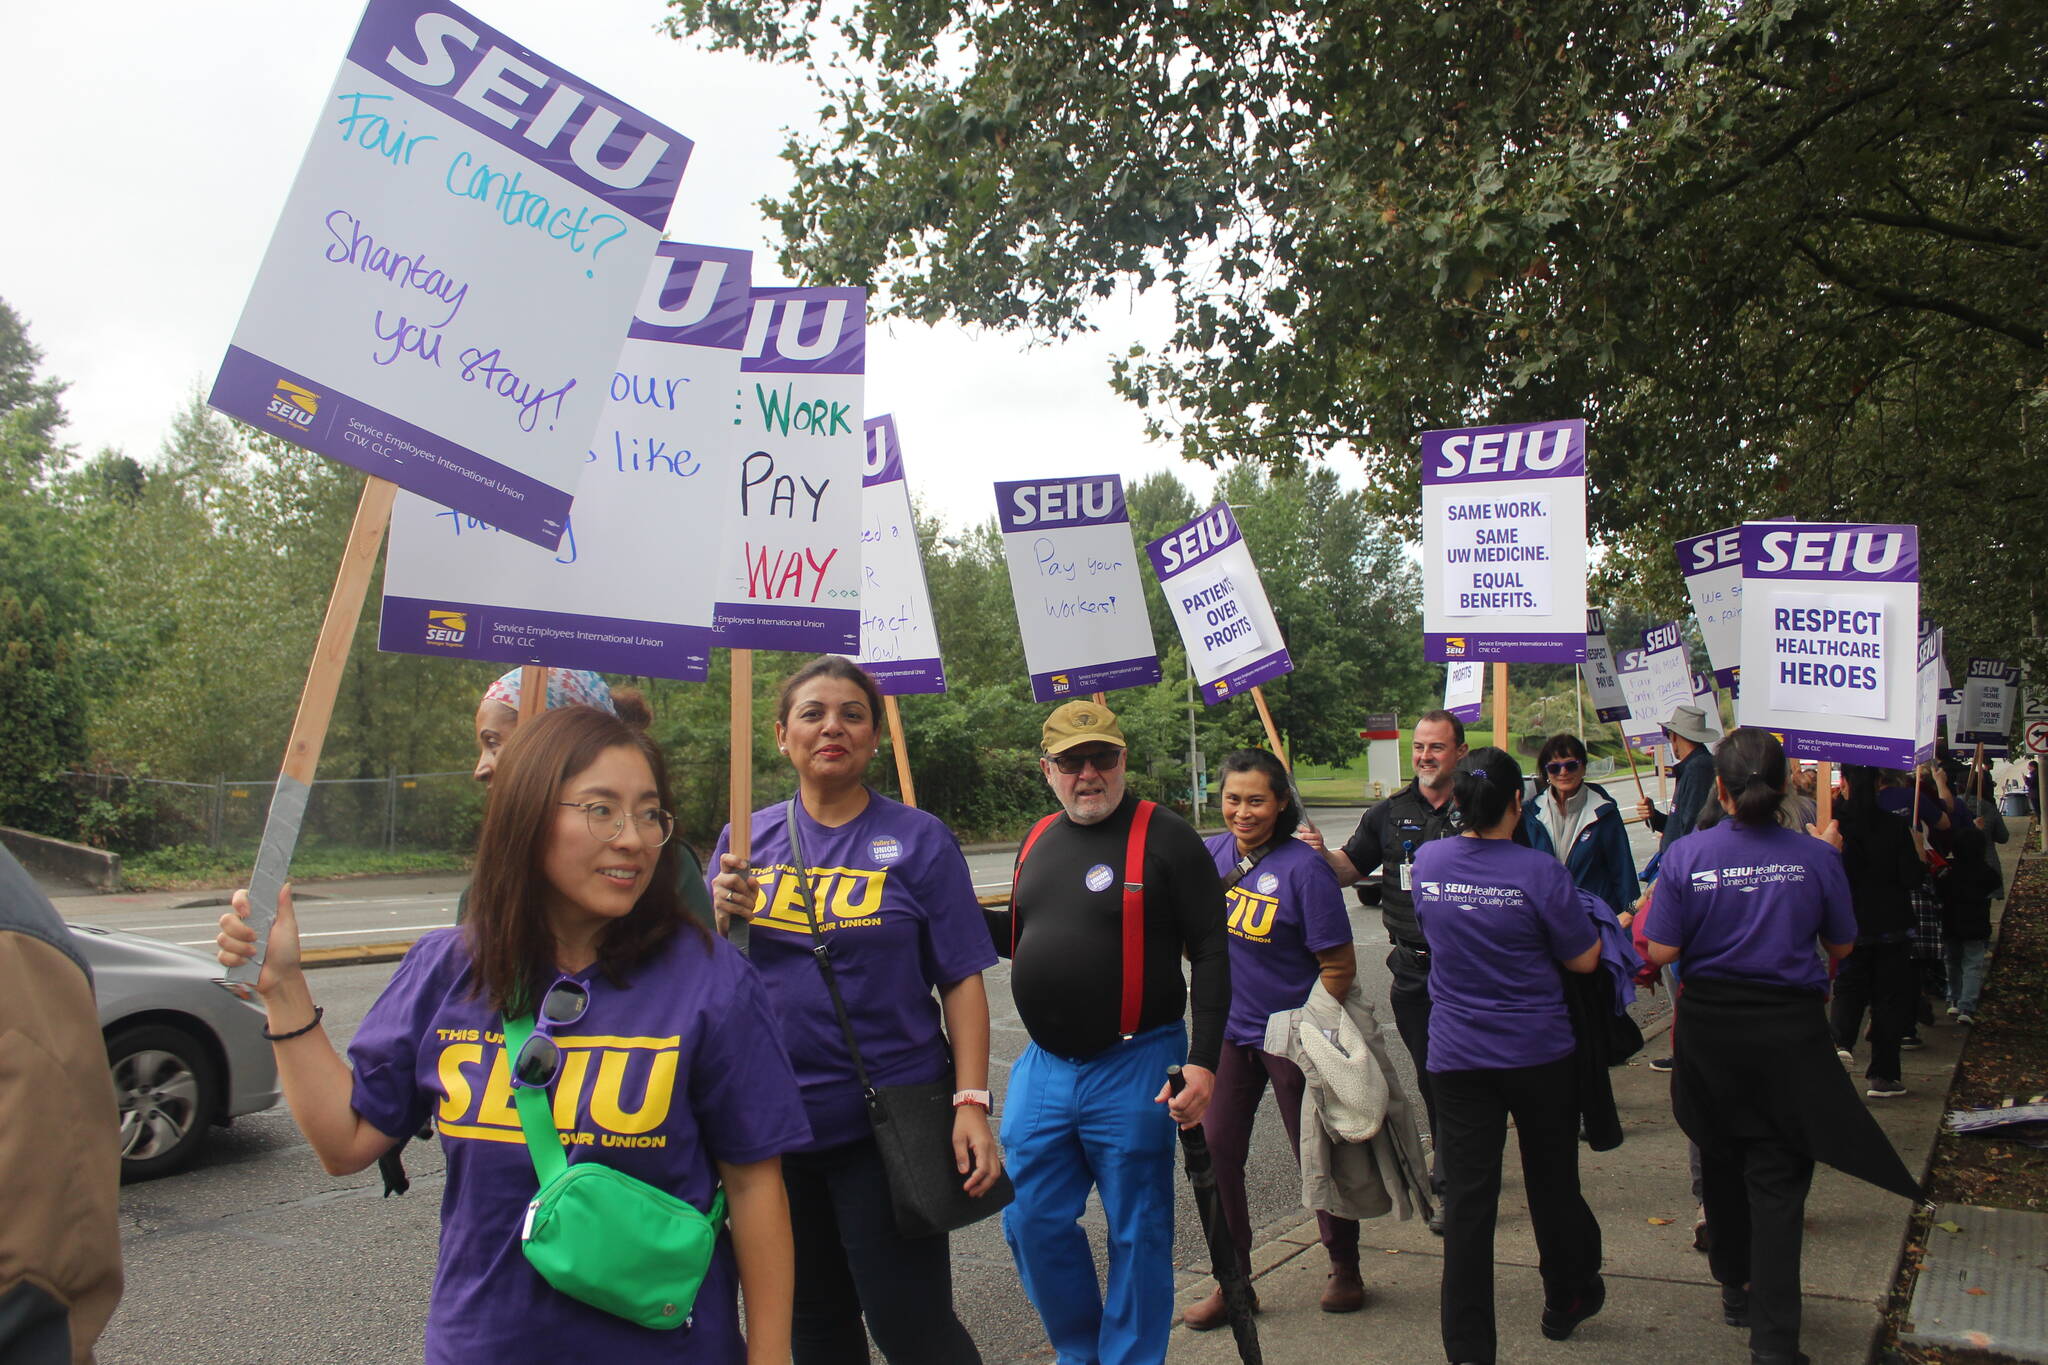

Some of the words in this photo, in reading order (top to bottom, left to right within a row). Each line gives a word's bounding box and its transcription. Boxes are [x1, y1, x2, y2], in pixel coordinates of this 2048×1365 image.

[385, 12, 670, 190] SEIU
[338, 92, 438, 165] Fair
[324, 209, 468, 329] Shantay
[741, 299, 848, 361] IU
[373, 309, 442, 366] you
[459, 347, 577, 433] stay!
[267, 400, 314, 425] SEIU
[349, 418, 383, 438] Service
[384, 432, 436, 463] Employees
[436, 456, 496, 488] International
[496, 482, 526, 502] Union
[371, 442, 393, 458] CLC
[615, 430, 701, 477] like
[1436, 428, 1572, 478] SEIU
[1012, 481, 1114, 525] SEIU
[1448, 503, 1492, 521] SAME
[1495, 500, 1547, 519] WORK.
[1160, 509, 1230, 573] SEIU
[1476, 528, 1518, 545] SAME
[1033, 538, 1076, 581] Pay
[1447, 548, 1471, 563] UW
[1474, 545, 1550, 563] MEDICINE.
[1692, 532, 1741, 570] SE
[1757, 531, 1903, 574] SEIU
[1473, 572, 1524, 589] EQUAL
[1460, 591, 1537, 609] BENEFITS.
[718, 615, 755, 626] Employees
[756, 617, 802, 628] International
[802, 620, 825, 629] Union
[1207, 601, 1239, 627] OVER
[1775, 608, 1881, 635] RESPECT
[425, 628, 465, 643] SEIU
[493, 622, 525, 635] Service
[526, 625, 575, 641] Employees
[576, 630, 634, 645] International
[635, 637, 664, 648] Union
[517, 637, 535, 647] CLC
[1204, 616, 1252, 651] PROFITS
[1647, 625, 1677, 652] SEIU
[1776, 638, 1880, 659] HEALTHCARE
[1780, 662, 1877, 690] HEROES
[1971, 660, 2004, 677] SEIU
[874, 845, 897, 853] UNION
[875, 852, 898, 860] STRONG
[750, 865, 774, 875] THIS
[1722, 877, 1748, 887] United
[1760, 874, 1786, 883] Quality
[1787, 872, 1805, 882] Care
[1225, 890, 1278, 936] IU
[1444, 894, 1467, 903] United
[1468, 895, 1477, 903] for
[1479, 896, 1504, 907] Quality
[1505, 898, 1523, 906] Care
[840, 918, 881, 928] UNION
[1228, 928, 1243, 937] OUR
[1244, 934, 1272, 943] UNION
[436, 1029, 480, 1041] THIS
[601, 1134, 666, 1148] UNION
